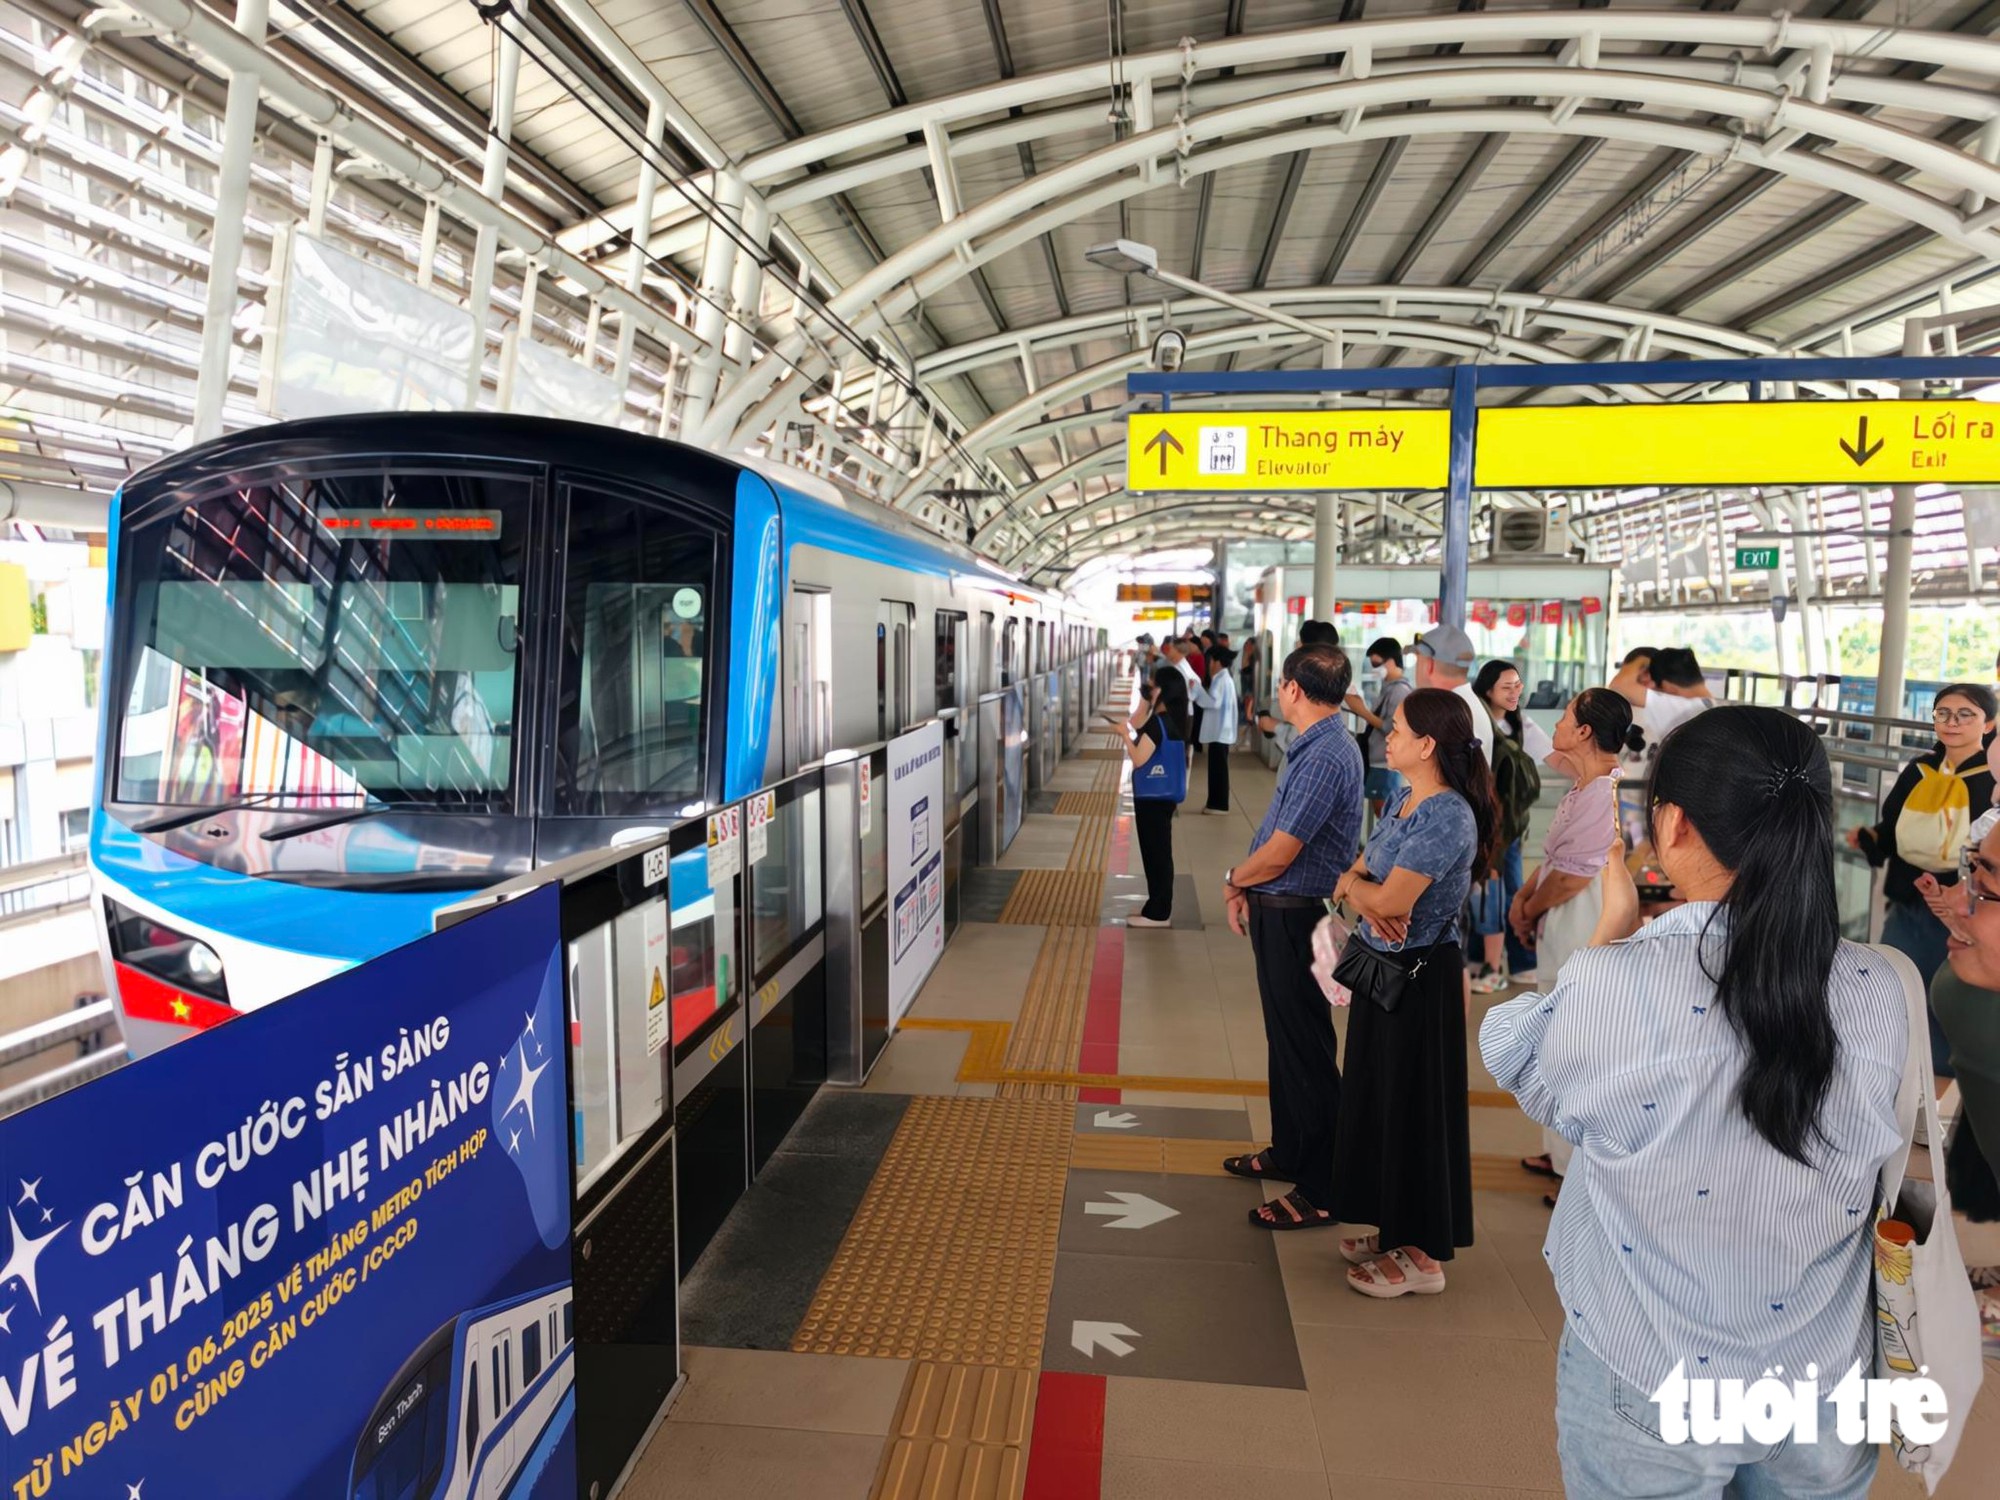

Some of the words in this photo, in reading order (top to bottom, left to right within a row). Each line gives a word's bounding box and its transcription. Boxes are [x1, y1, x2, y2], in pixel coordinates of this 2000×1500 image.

[1258, 459, 1331, 475] Elevator
[1259, 425, 1338, 453] Thang
[1349, 425, 1403, 453] máy
[1913, 411, 1955, 439] Lối
[1966, 421, 1994, 439] ra
[1743, 551, 1771, 566] EXIT
[81, 1162, 183, 1256] CĂN
[195, 1096, 307, 1189] CƯỚC
[315, 1052, 374, 1120] SẴN
[382, 1016, 450, 1081] SÀNG
[0, 1314, 77, 1436] VÉ
[93, 1203, 279, 1369] THÁNG
[292, 1138, 369, 1233] NHẸ
[379, 1061, 490, 1171] NHÀNG
[13, 1453, 53, 1500] TỪ
[61, 1389, 143, 1476] NGÀY
[150, 1291, 274, 1405] 01.06.2025
[277, 1263, 302, 1303] VÉ
[306, 1220, 368, 1282] THÁNG
[372, 1178, 422, 1232] METRO
[425, 1150, 457, 1189] TÍCH
[460, 1128, 487, 1163] HỢP
[175, 1359, 245, 1431] CÙNG
[250, 1315, 296, 1369] CĂN
[301, 1268, 357, 1327] CƯỚC
[361, 1218, 418, 1282] /CCCD
